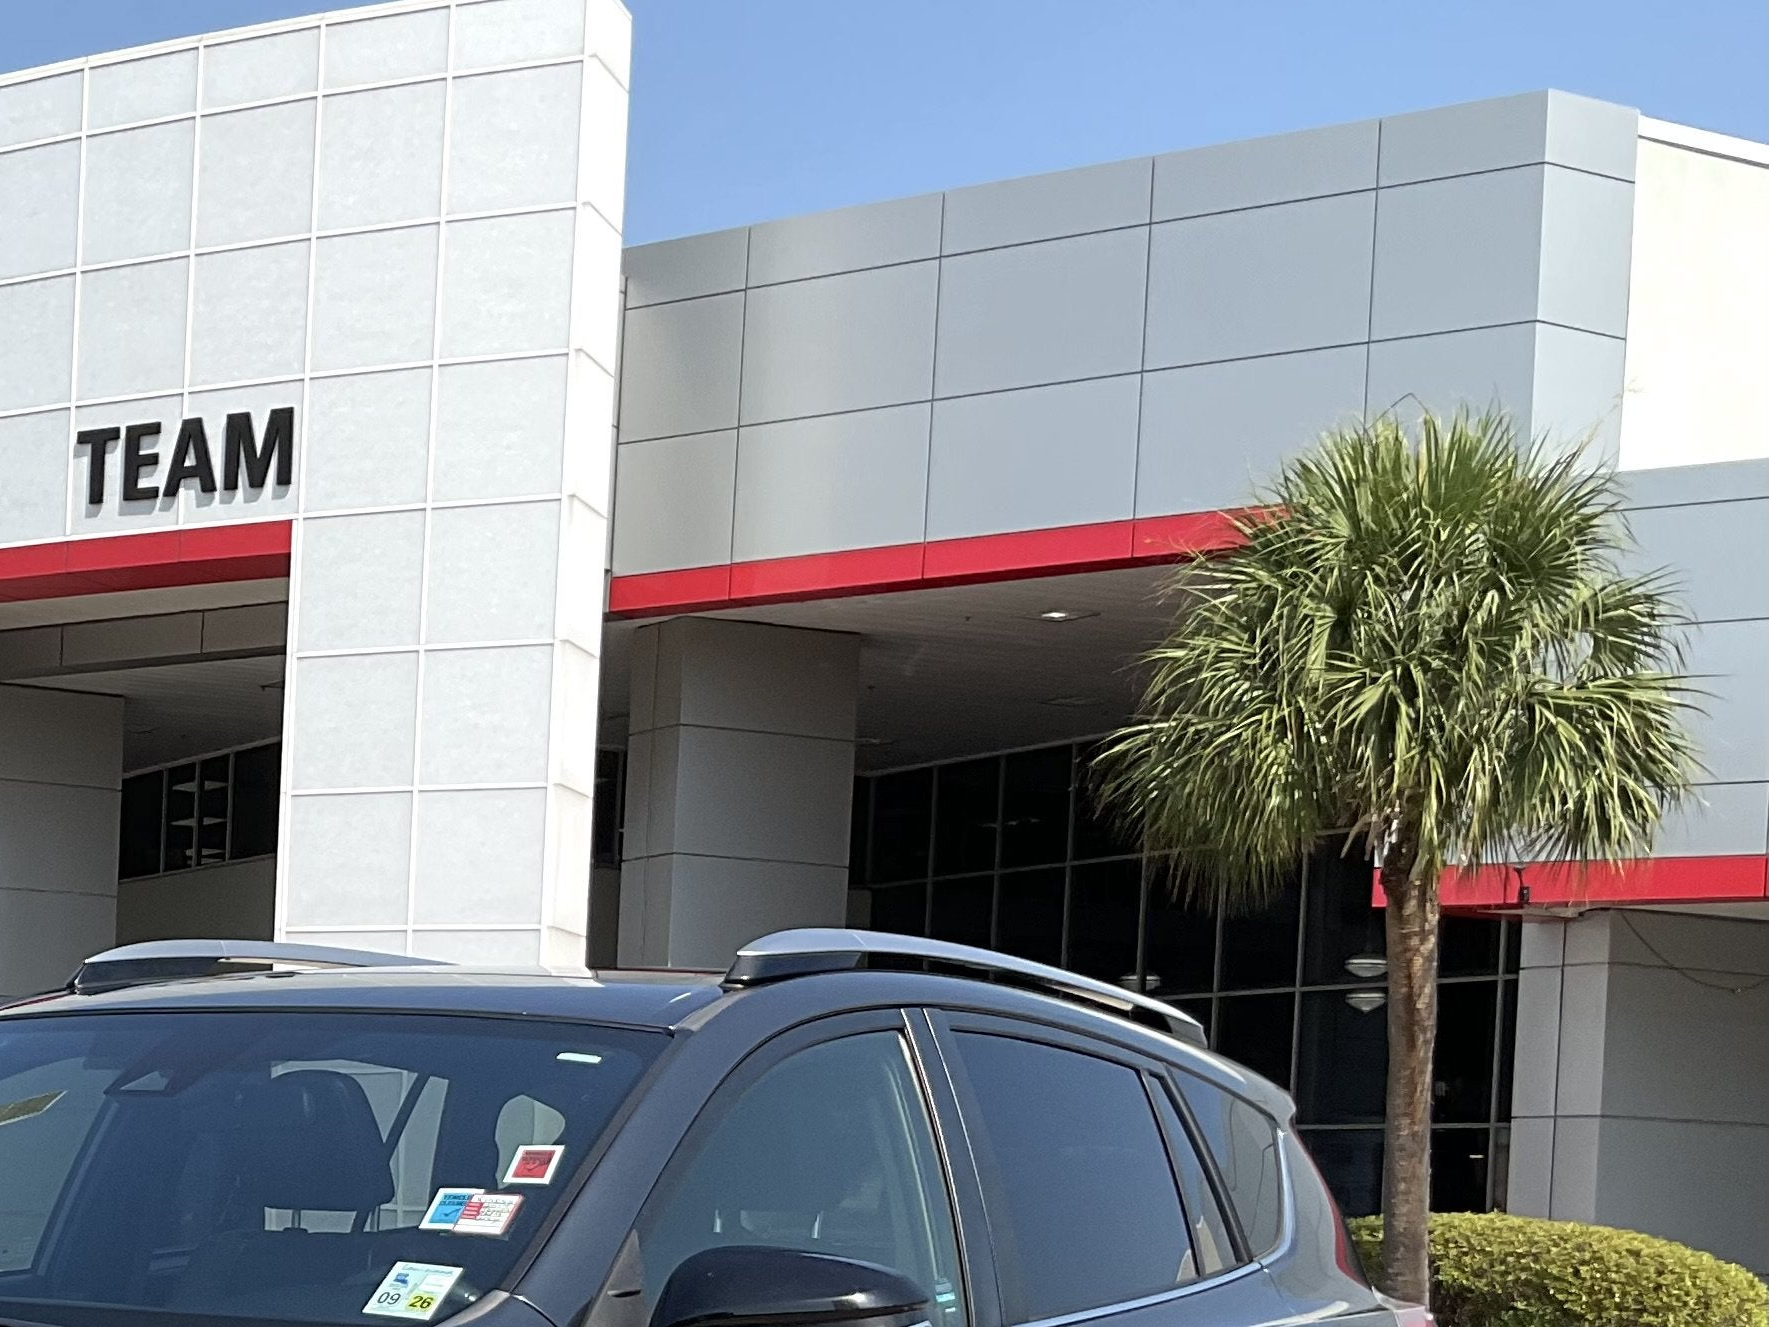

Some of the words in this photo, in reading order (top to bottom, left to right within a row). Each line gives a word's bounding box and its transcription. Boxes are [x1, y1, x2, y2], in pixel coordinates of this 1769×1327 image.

[77, 406, 295, 505] TEAM
[377, 1291, 401, 1305] 09
[409, 1295, 434, 1309] 26
